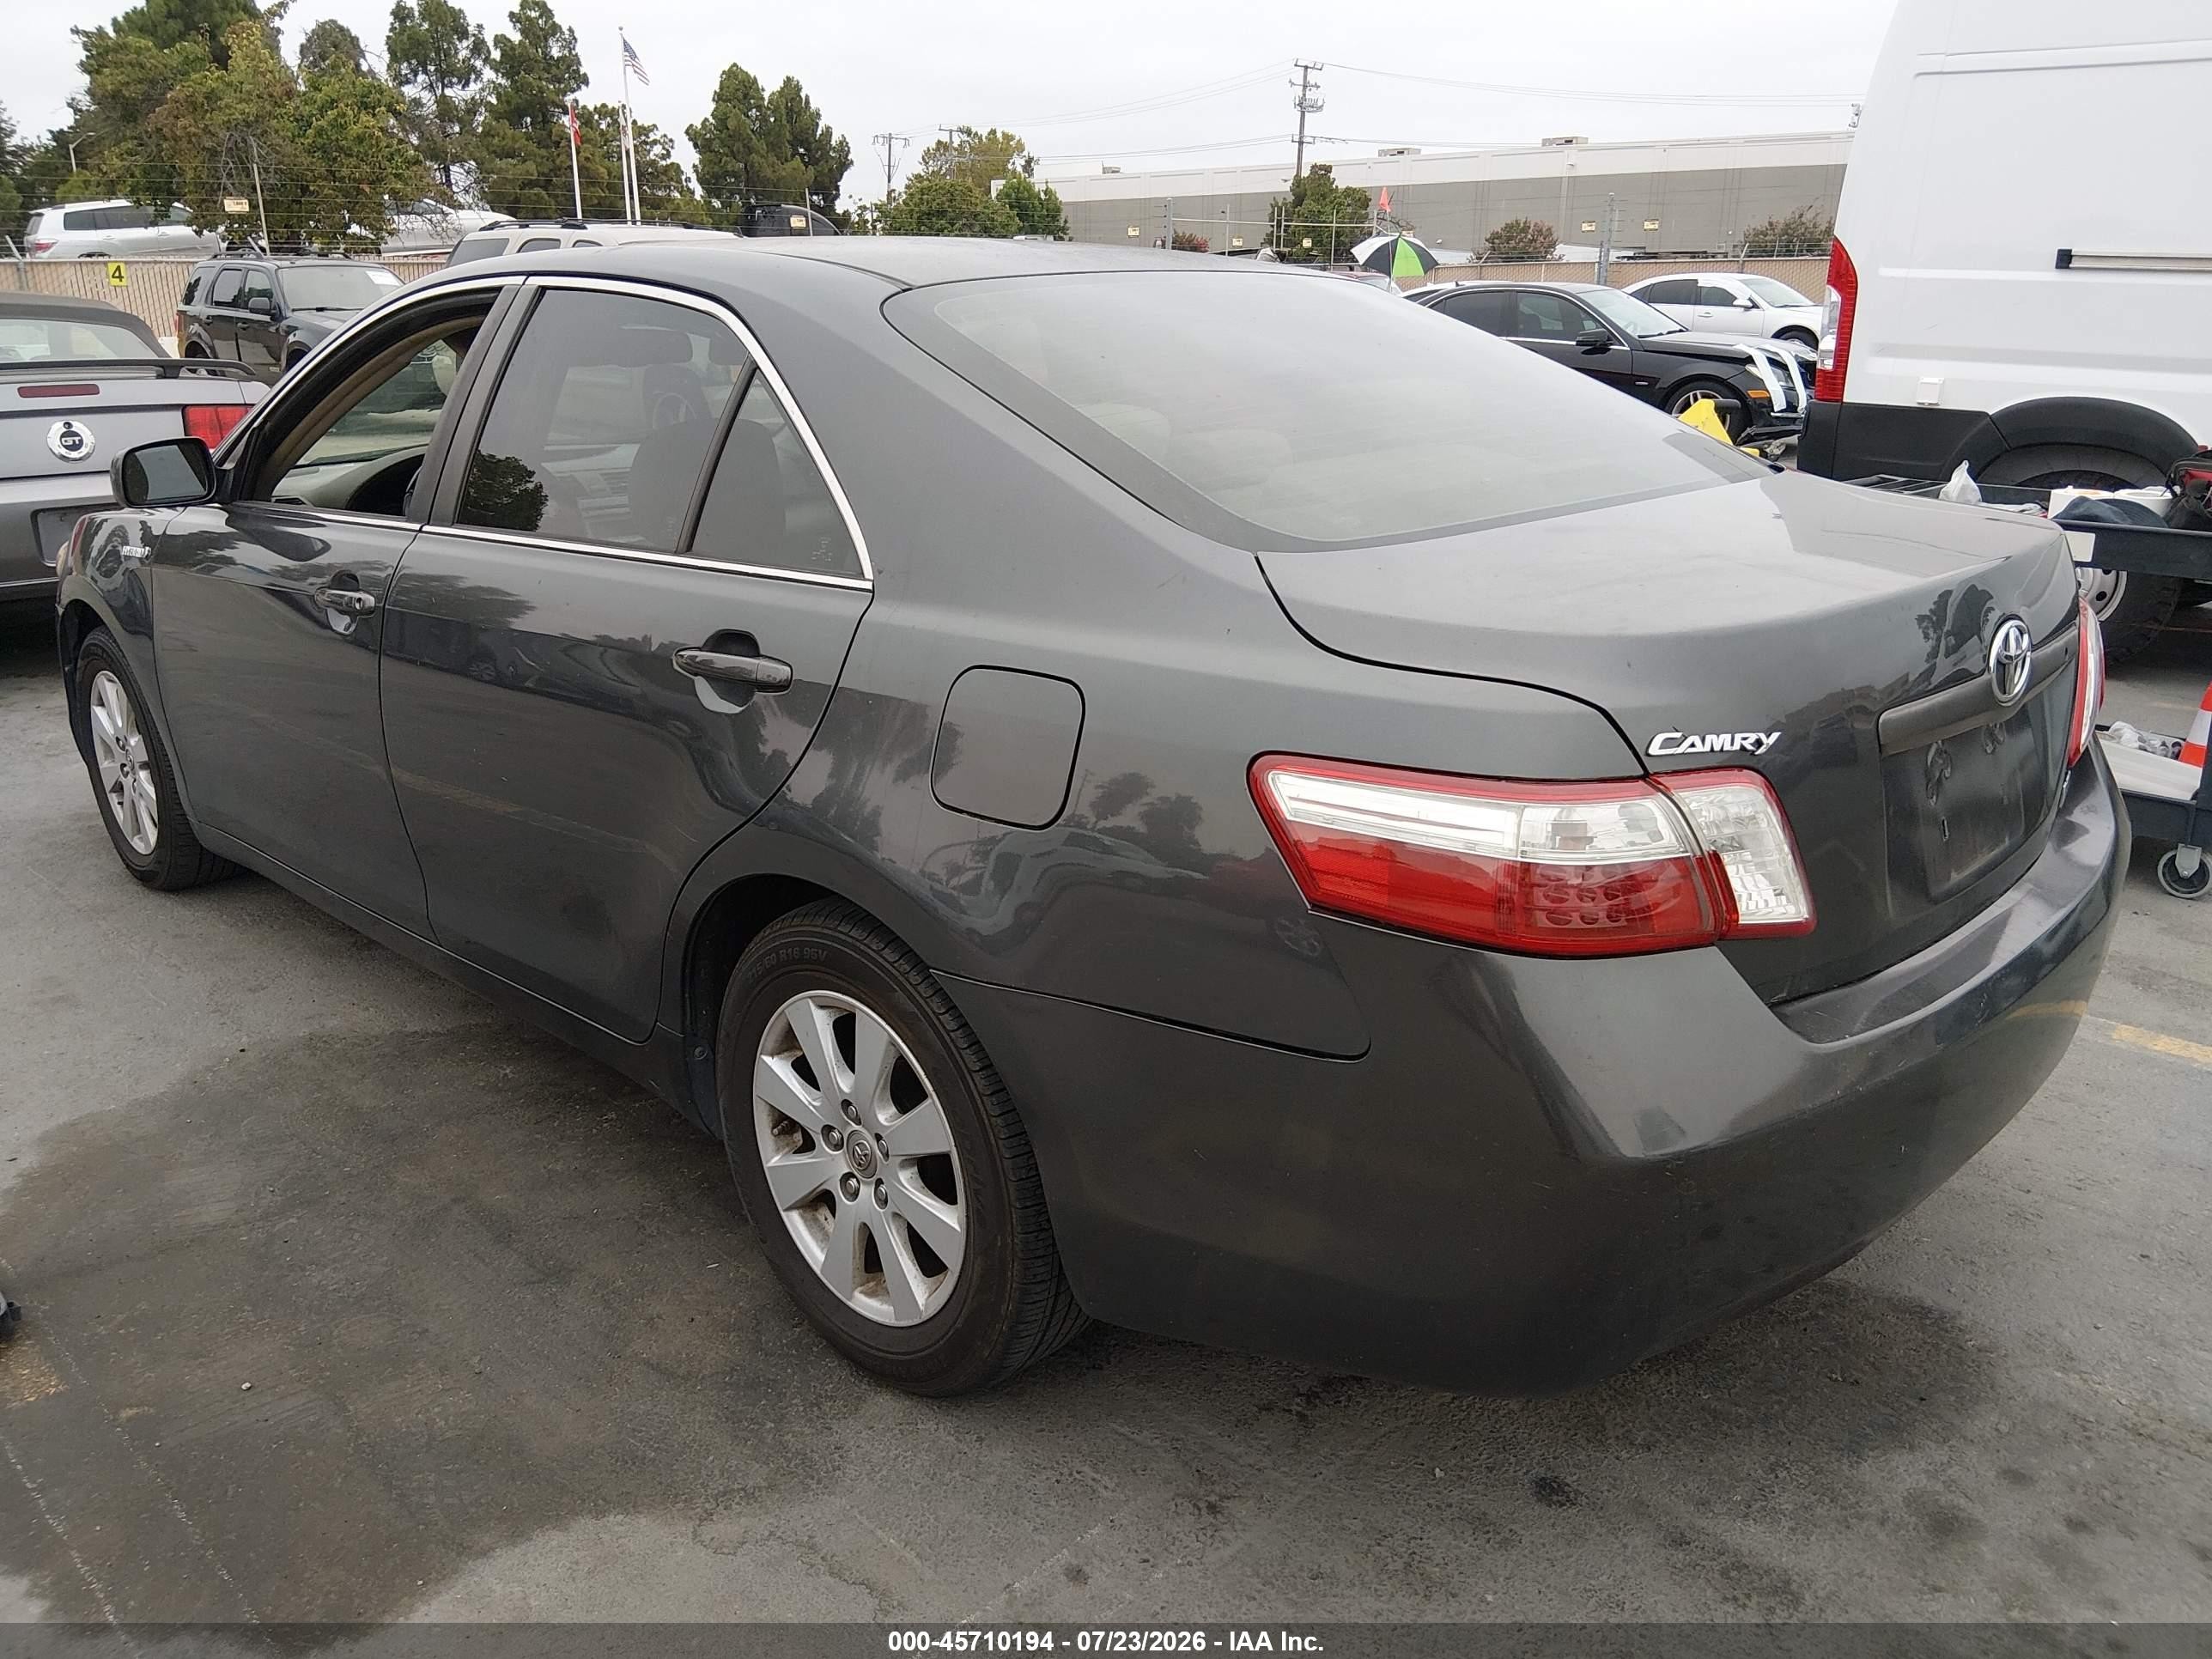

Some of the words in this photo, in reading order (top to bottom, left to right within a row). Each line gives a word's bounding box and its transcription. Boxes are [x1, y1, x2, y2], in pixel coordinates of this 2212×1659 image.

[112, 264, 125, 283] 4
[61, 436, 82, 446] GT
[1647, 732, 1782, 757] CAMRY
[779, 947, 800, 962] R16
[803, 947, 828, 961] 95V
